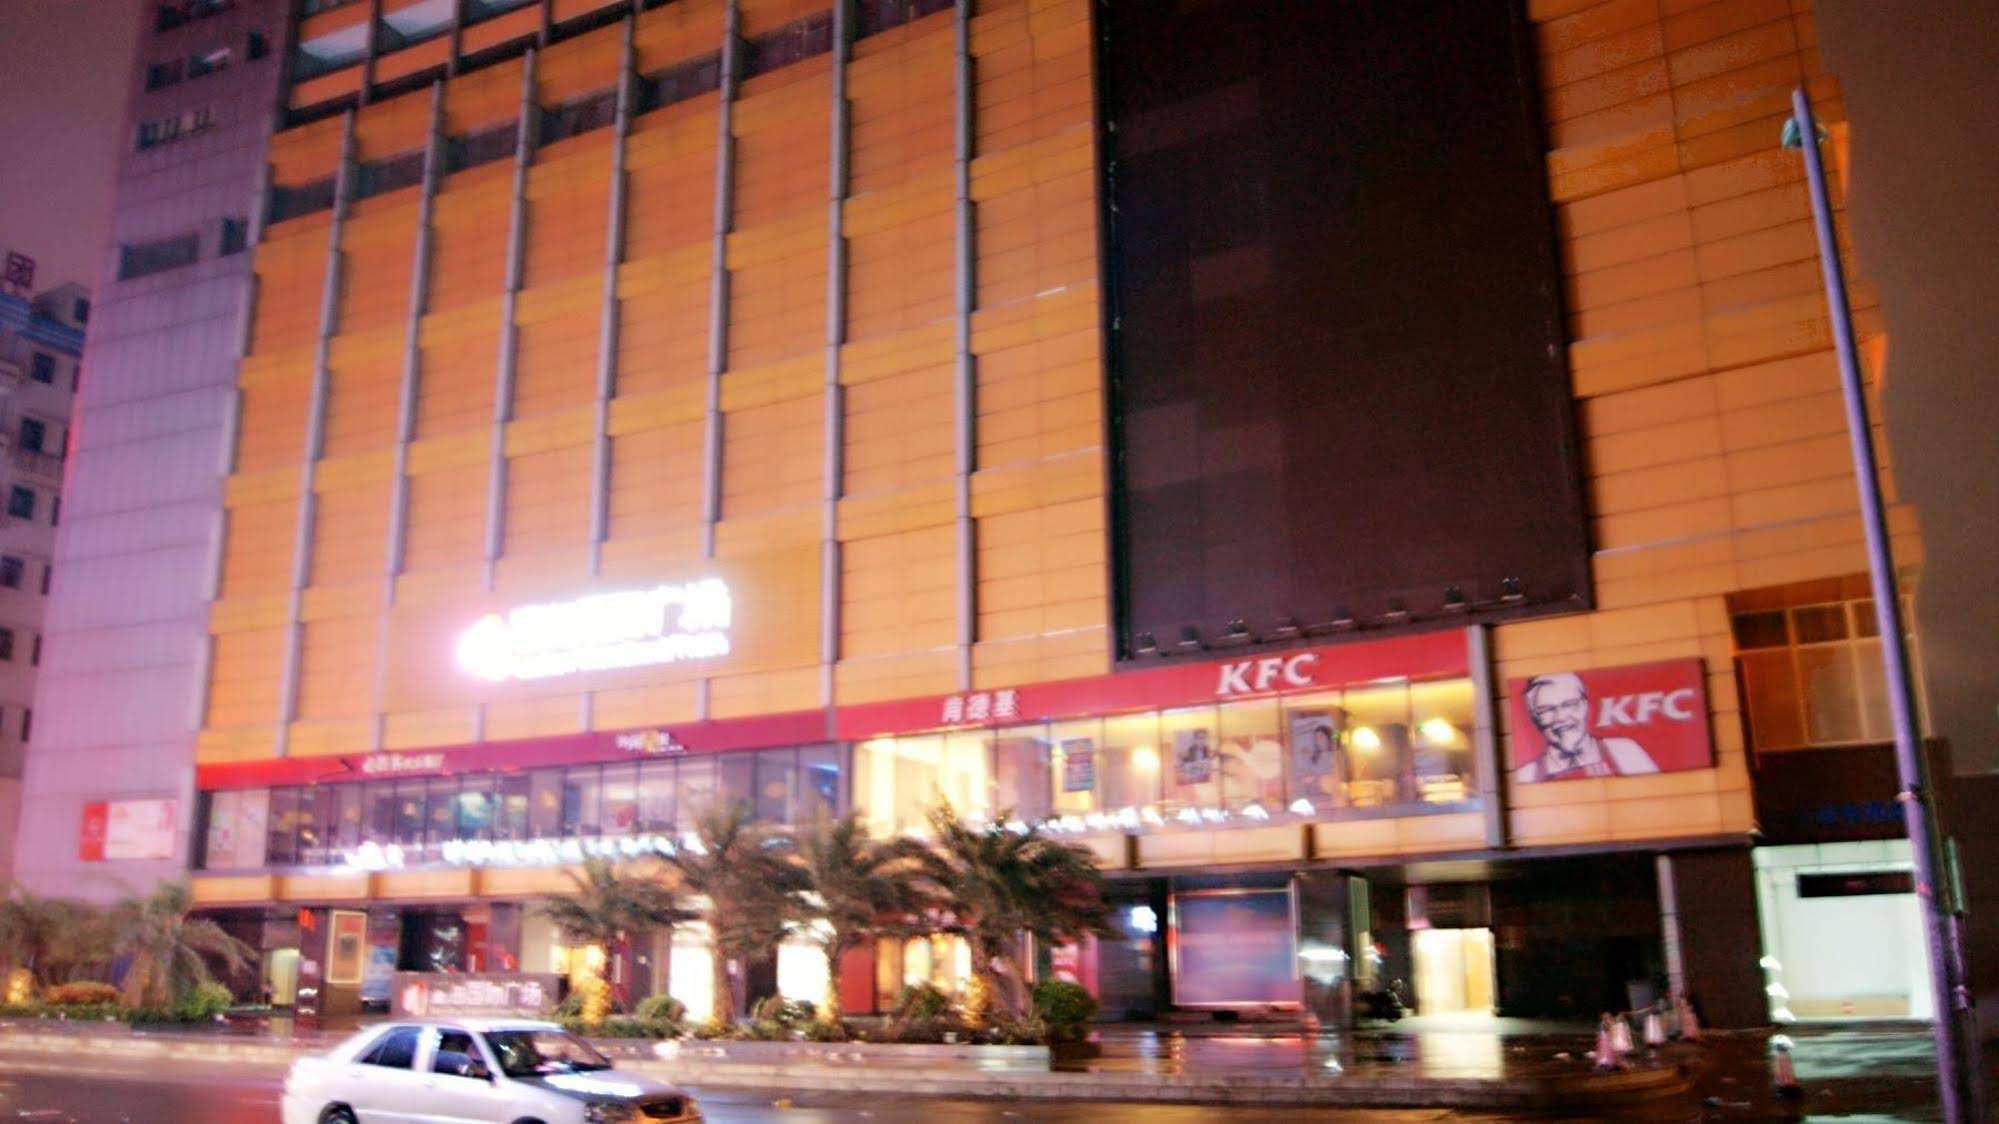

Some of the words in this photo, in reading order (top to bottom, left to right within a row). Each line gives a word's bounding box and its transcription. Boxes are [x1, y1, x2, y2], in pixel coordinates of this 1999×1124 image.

[1218, 653, 1316, 695] KFC
[942, 689, 1018, 722] 肯德基
[1596, 688, 1694, 728] KFC
